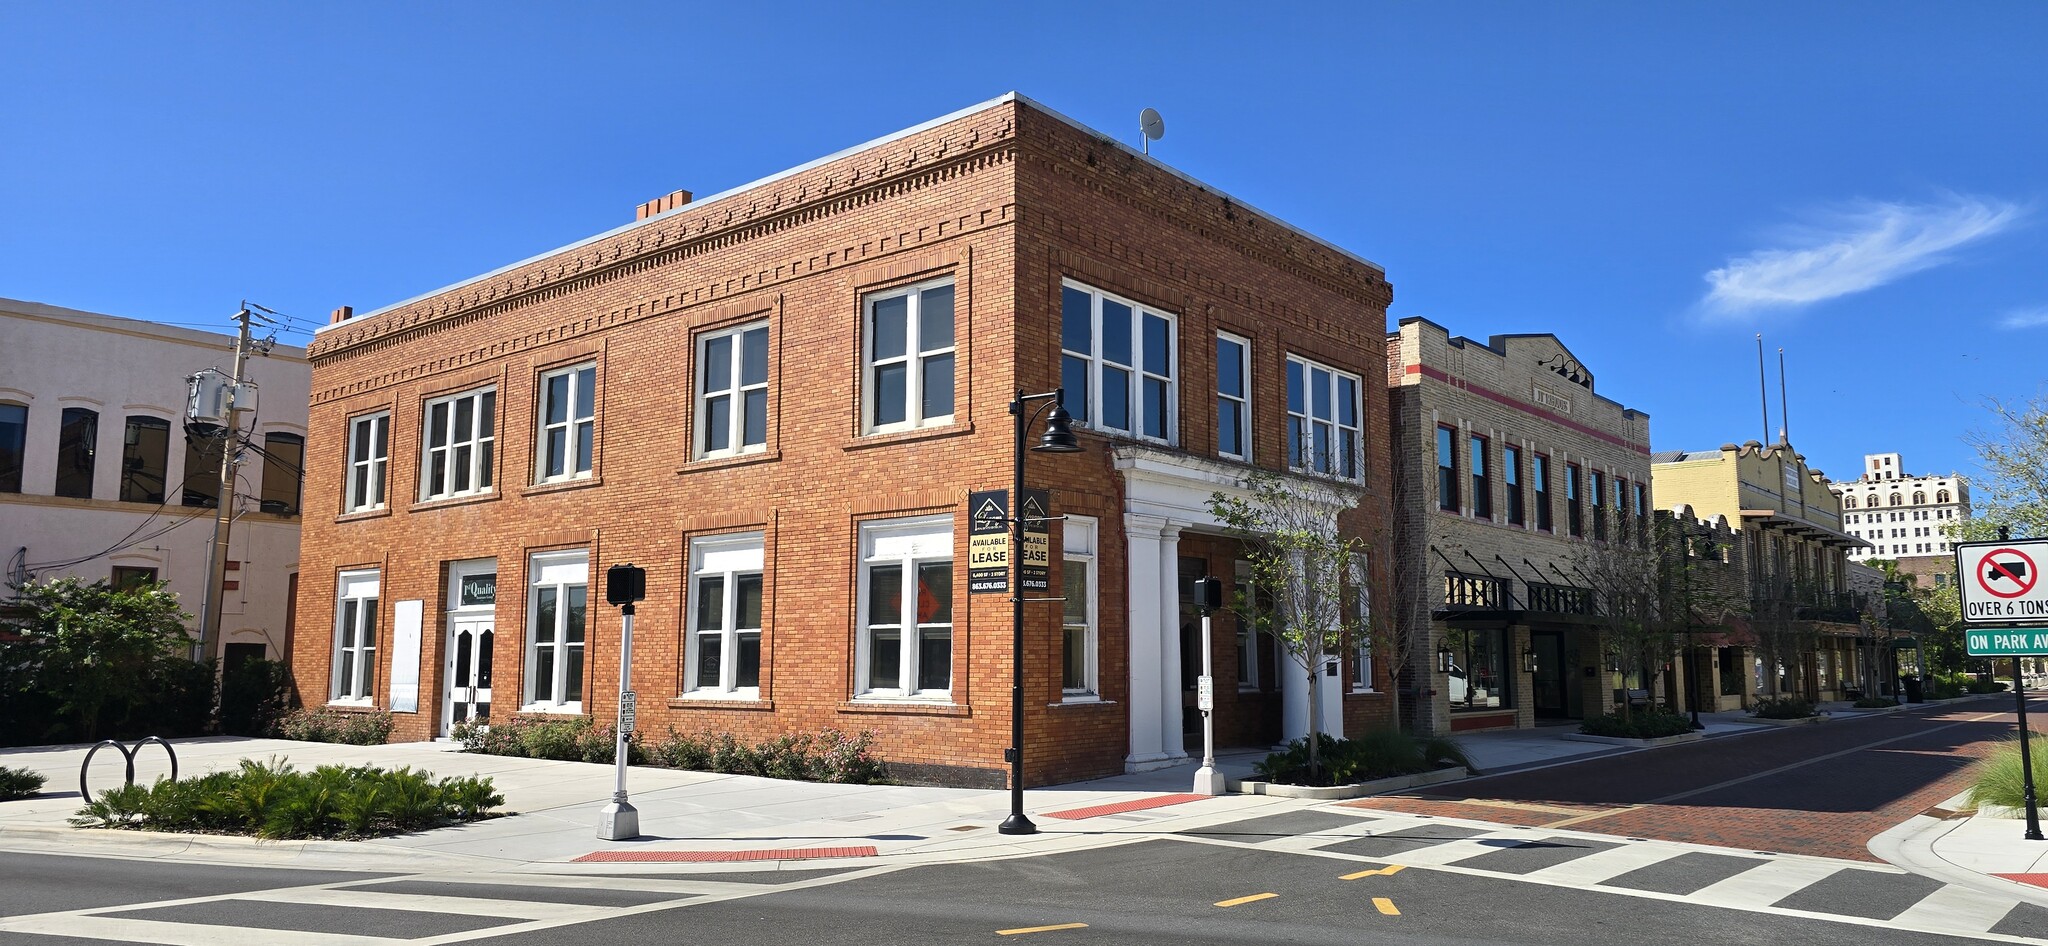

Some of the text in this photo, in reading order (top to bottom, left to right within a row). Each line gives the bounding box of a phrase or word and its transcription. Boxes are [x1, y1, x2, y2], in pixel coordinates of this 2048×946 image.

[972, 538, 1006, 546] AVAILABLE
[972, 552, 1006, 563] LEASE
[1023, 550, 1046, 561] EASE
[1969, 601, 2002, 616] OVER
[2006, 601, 2014, 615] 6
[1970, 634, 1988, 650] ON
[1994, 634, 2029, 650] PARK
